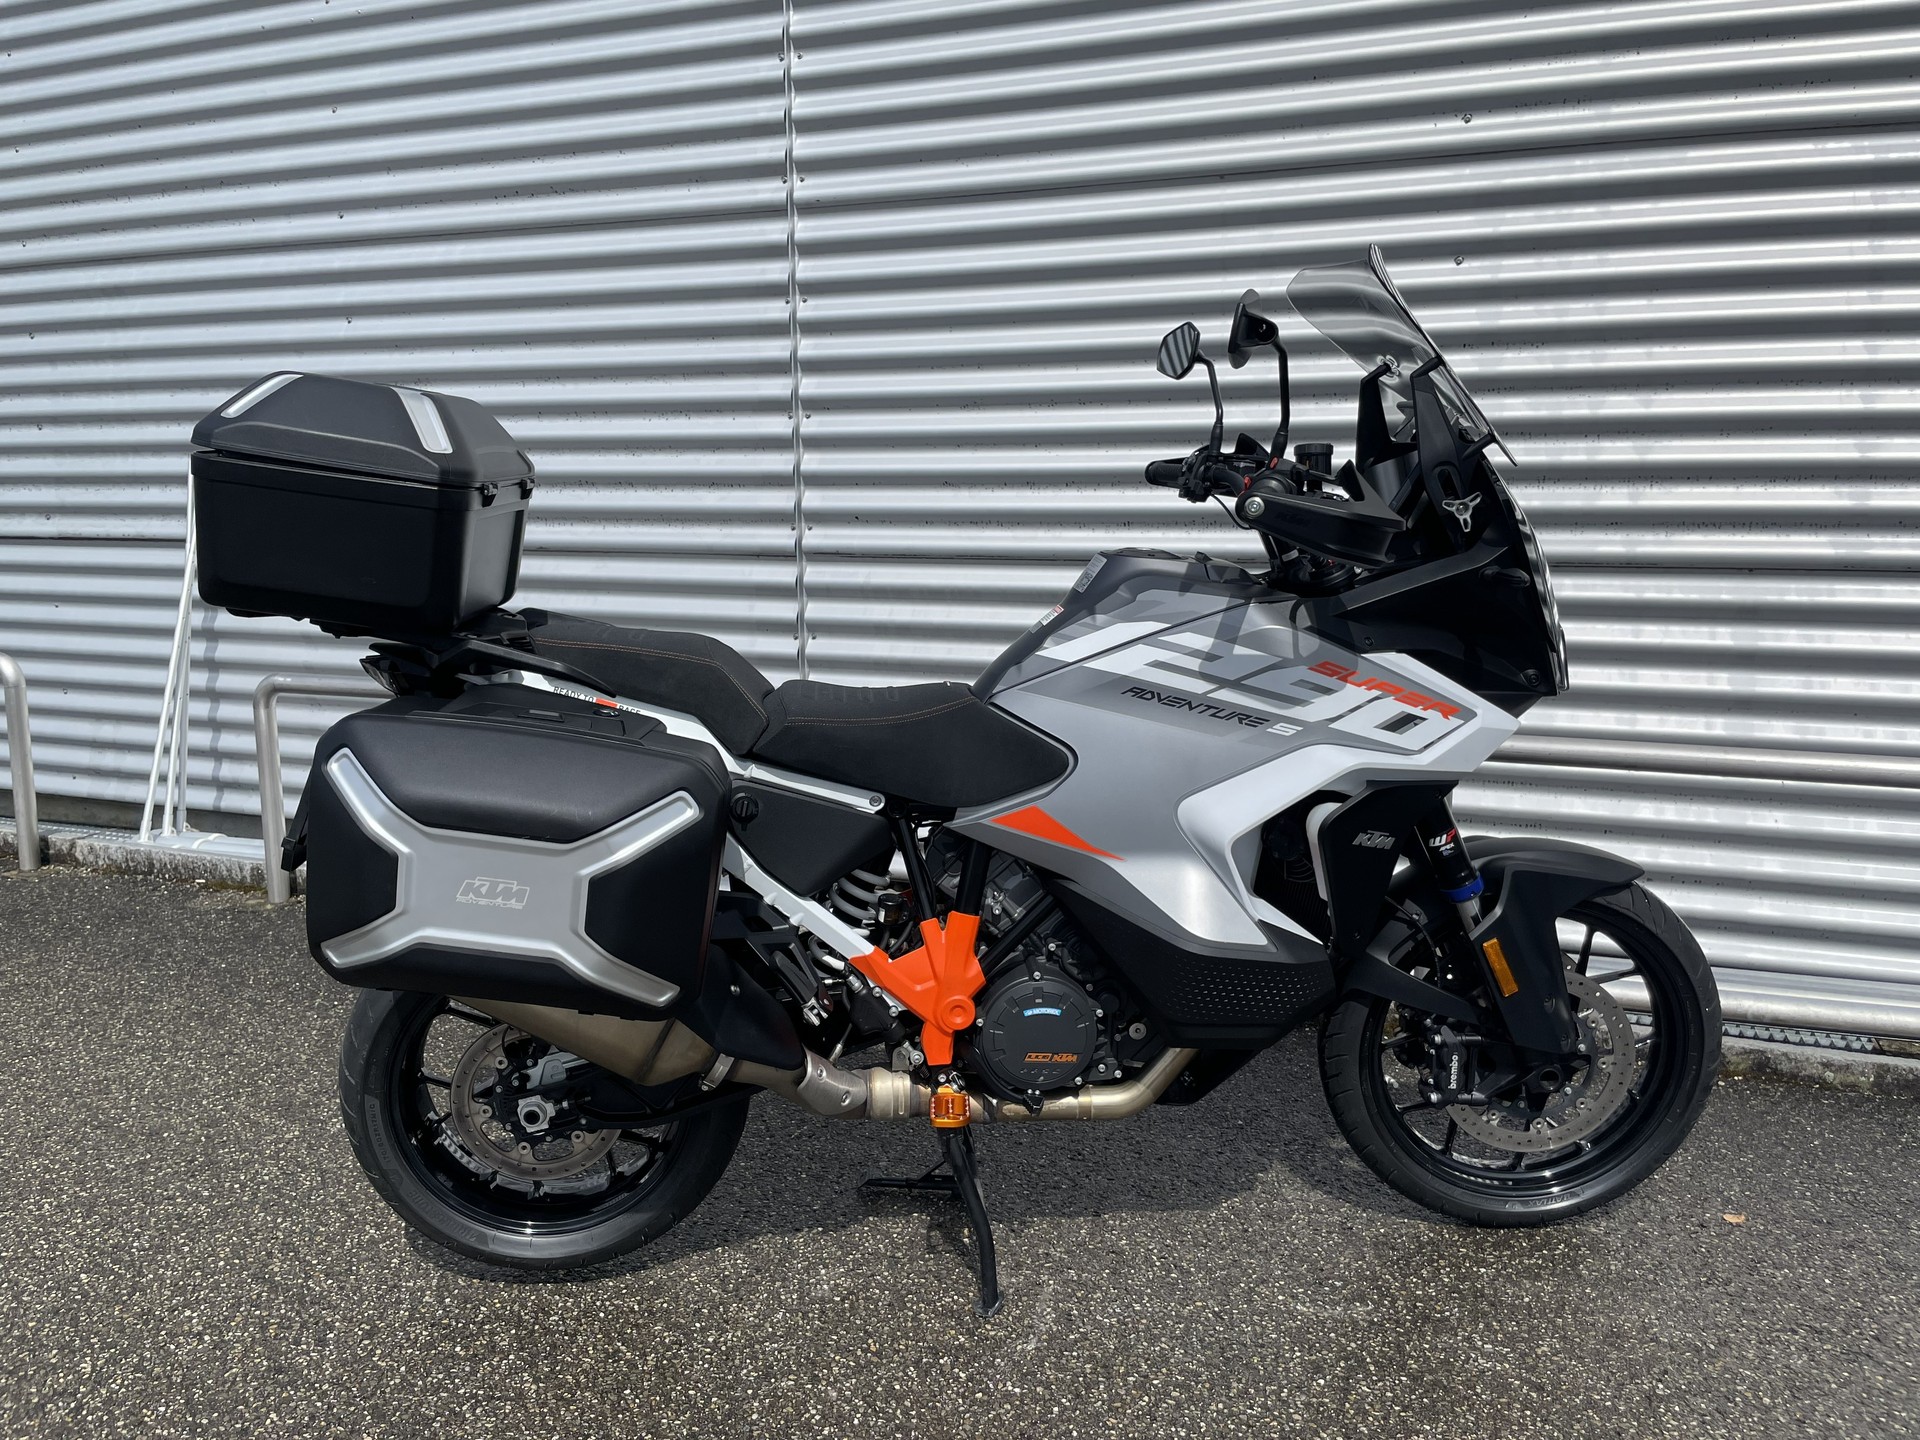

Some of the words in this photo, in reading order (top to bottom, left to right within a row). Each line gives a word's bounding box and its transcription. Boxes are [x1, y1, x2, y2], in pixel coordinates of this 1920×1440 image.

[554, 686, 581, 698] READY
[1306, 660, 1461, 721] SUPER
[1120, 686, 1270, 728] ADVENTURE
[1266, 721, 1303, 737] S
[1352, 830, 1396, 850] KTM
[1429, 828, 1456, 846] WP
[456, 876, 530, 906] KTM
[1448, 1054, 1459, 1089] brembo
